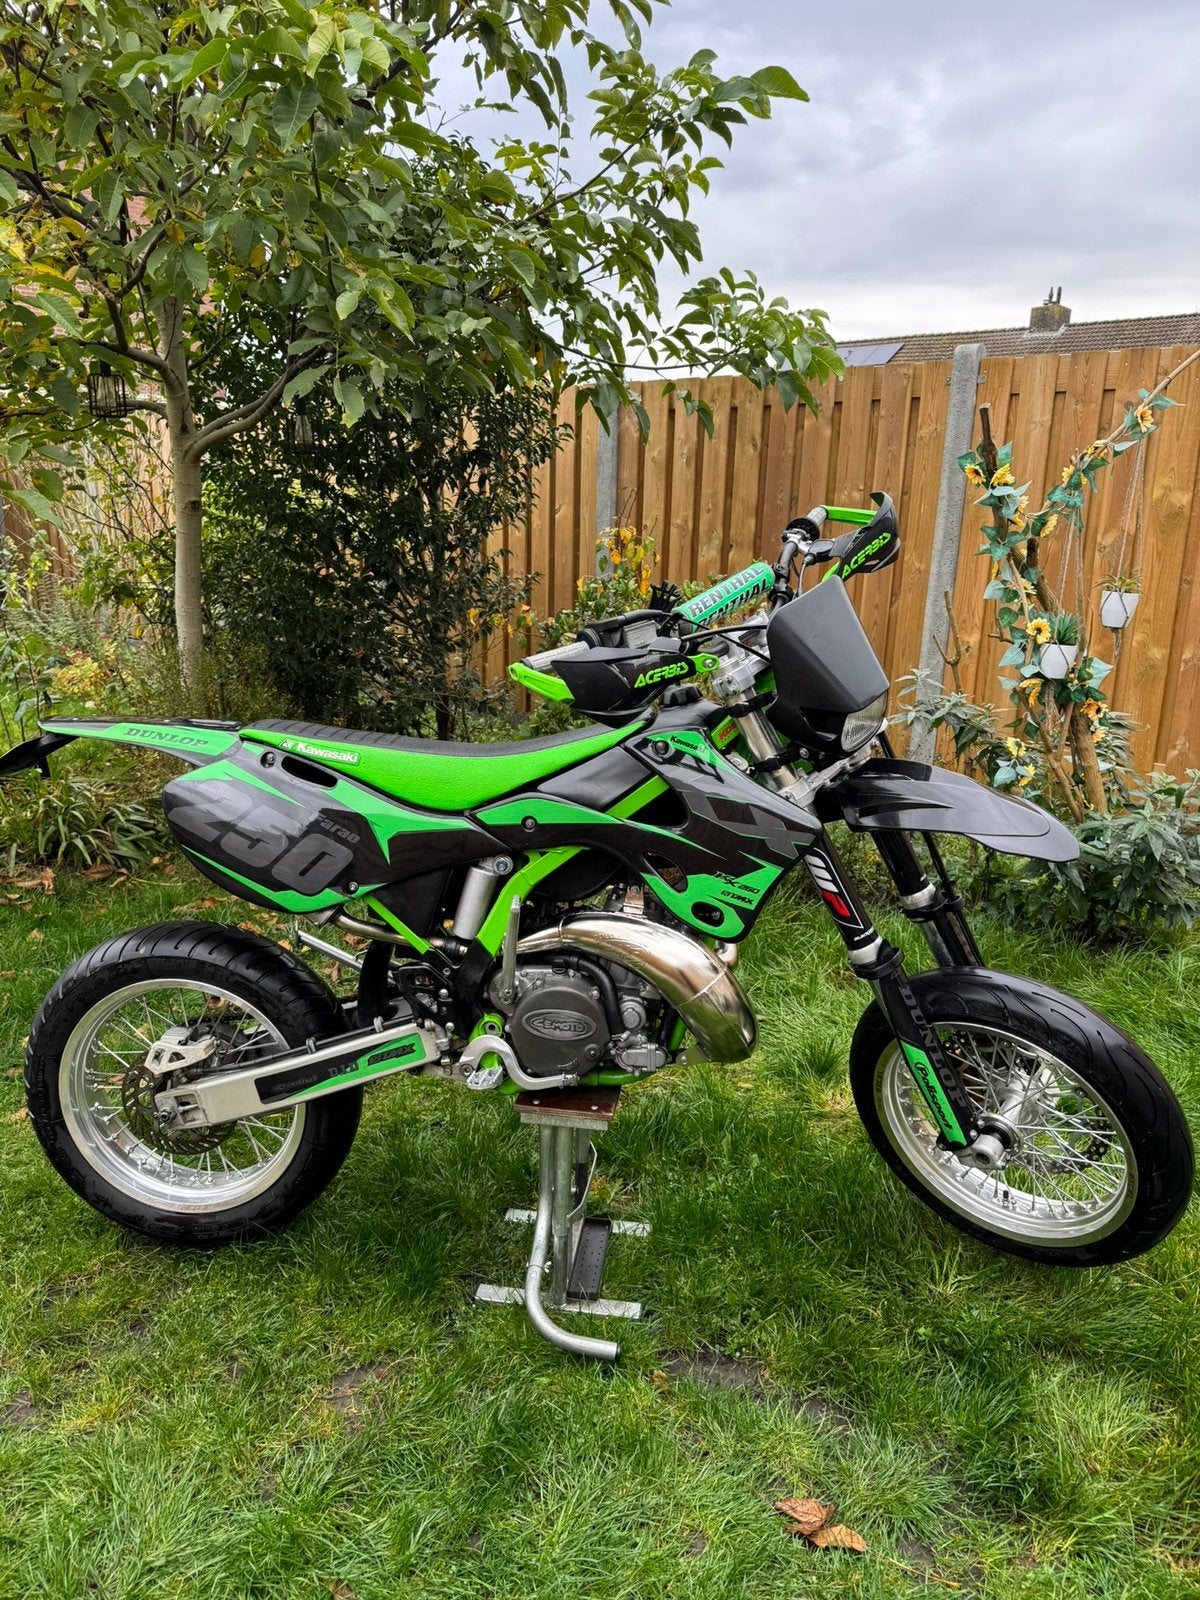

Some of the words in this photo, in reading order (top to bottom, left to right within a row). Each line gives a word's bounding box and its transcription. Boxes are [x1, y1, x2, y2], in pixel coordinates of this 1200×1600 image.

[842, 532, 891, 579] ACERBIS
[688, 567, 764, 617] RENTHAL
[634, 661, 689, 688] ACERBIS
[123, 728, 209, 746] DUNLOP
[296, 741, 359, 762] Kawasaki
[166, 779, 354, 895] 250
[899, 984, 966, 1107] DUNLOP
[915, 1061, 954, 1130] Polisport
